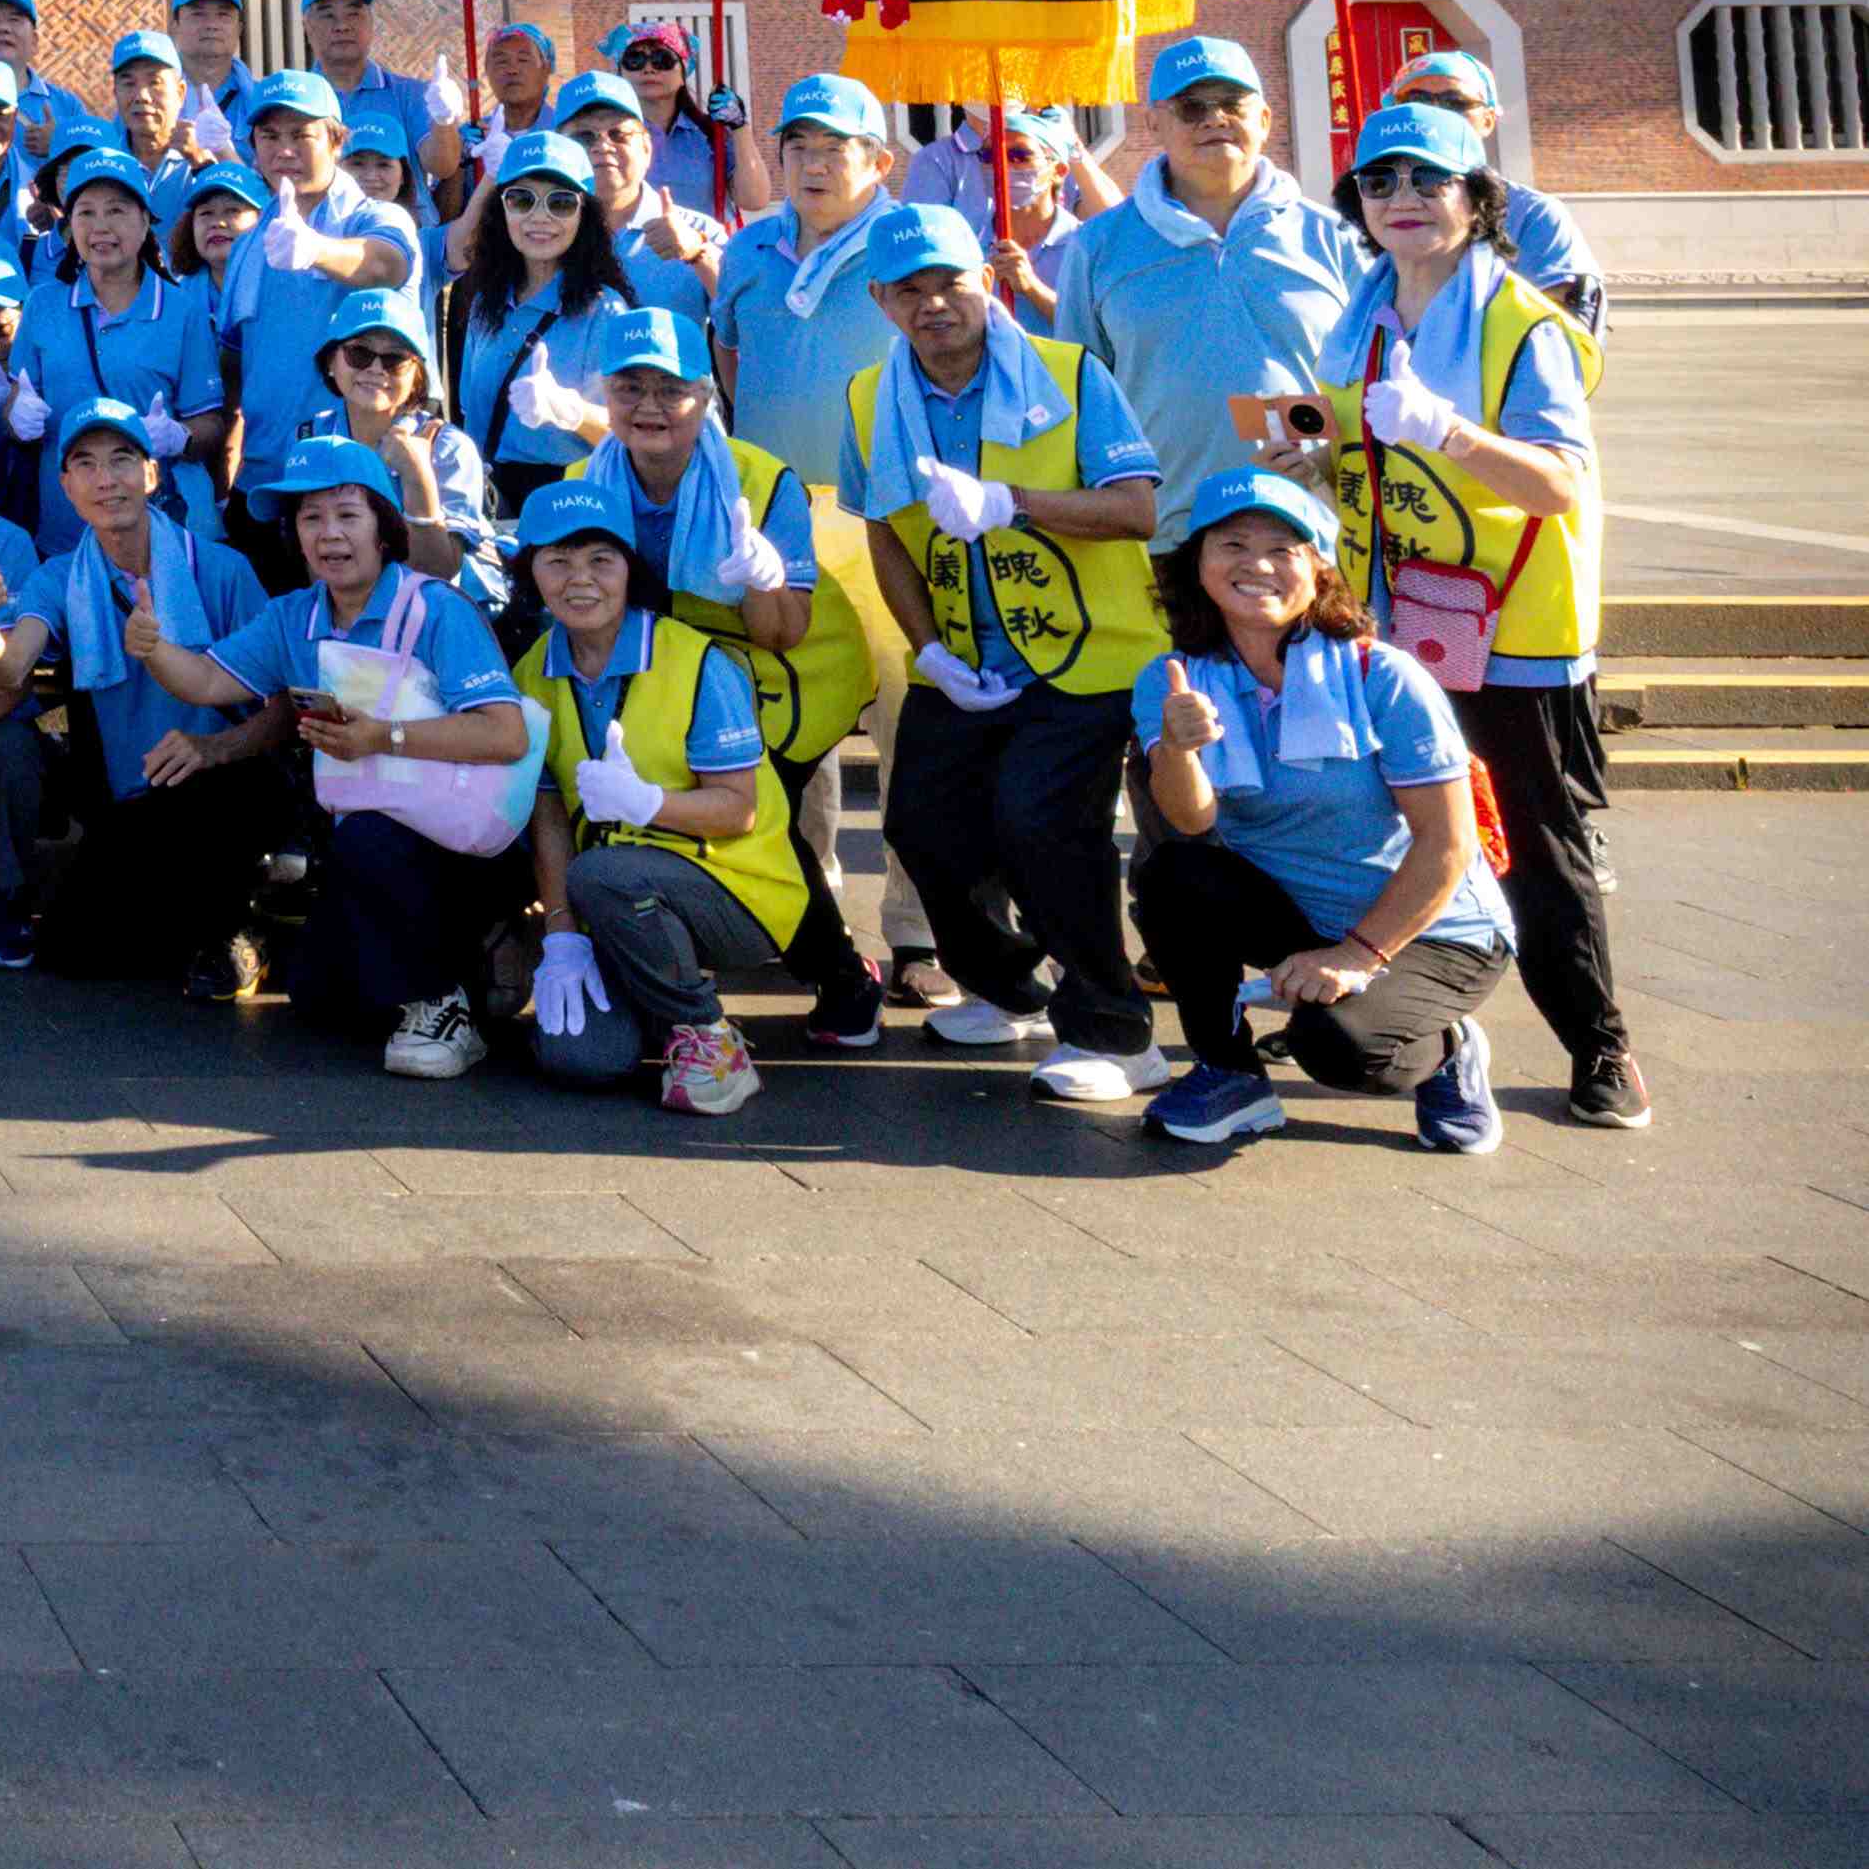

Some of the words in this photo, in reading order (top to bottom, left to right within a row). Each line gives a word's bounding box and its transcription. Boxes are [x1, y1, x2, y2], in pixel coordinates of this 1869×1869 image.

[264, 81, 307, 96] HAKKA
[795, 90, 841, 105] HAKKA
[67, 125, 103, 138] HAKKA
[1380, 121, 1439, 137] HAKKA
[86, 158, 126, 173] HAKKA
[205, 170, 243, 183] HAKKA
[552, 495, 604, 511] HAKKA
